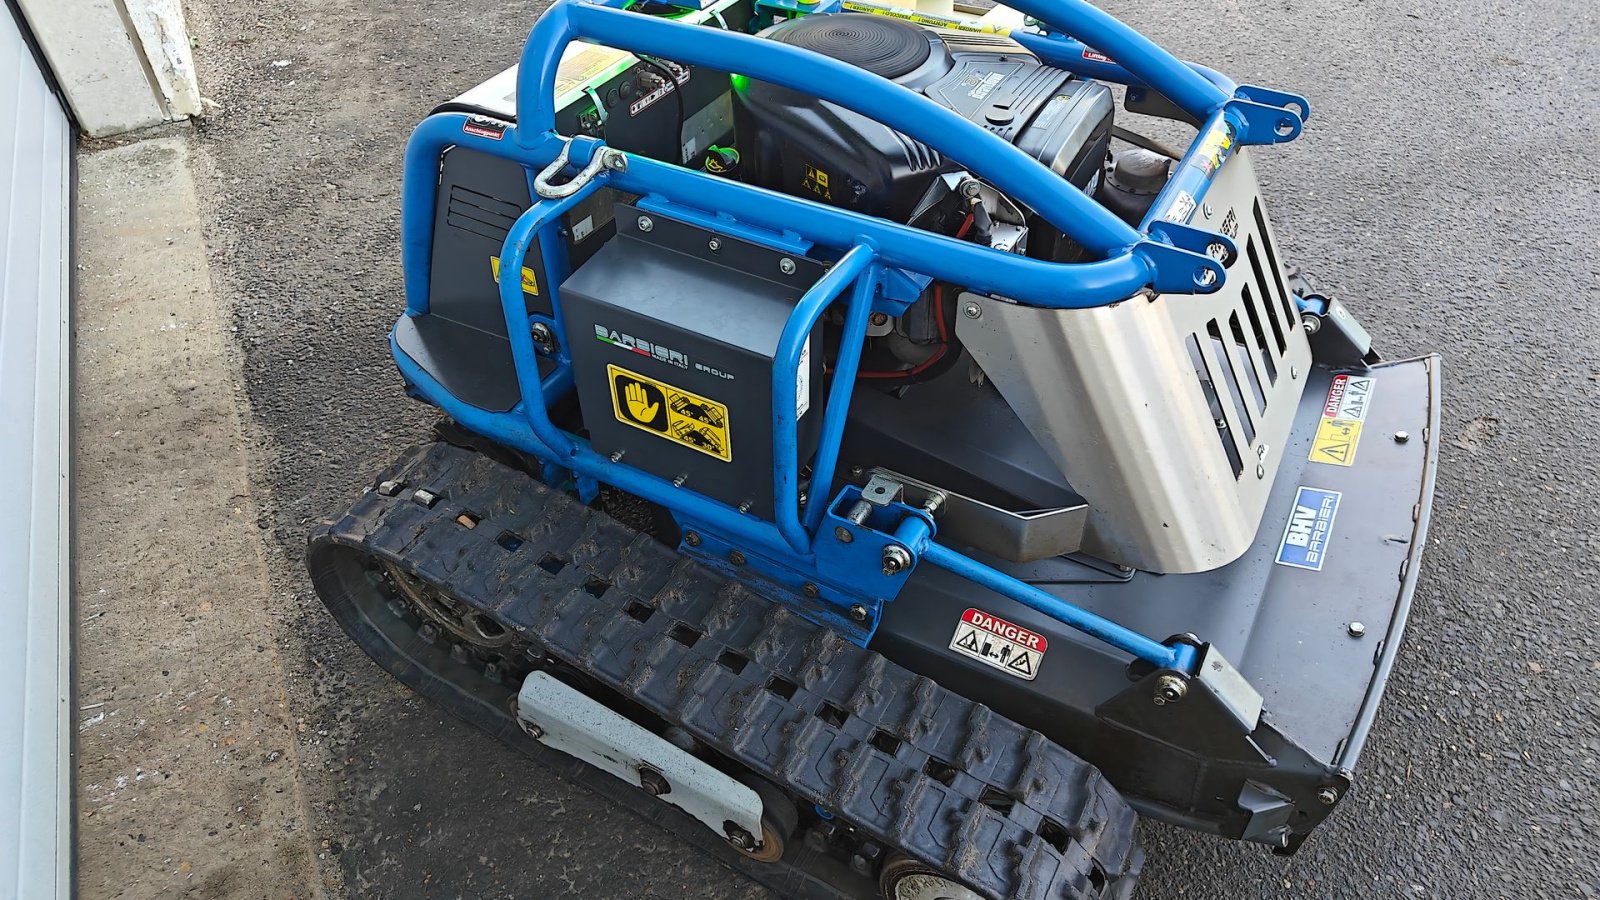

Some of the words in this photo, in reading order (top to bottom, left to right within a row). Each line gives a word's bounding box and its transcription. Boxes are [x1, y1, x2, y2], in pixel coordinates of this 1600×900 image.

[594, 323, 689, 366] BARBIERI
[695, 362, 735, 380] GROUP
[1326, 378, 1347, 414] DANGER
[1286, 504, 1318, 548] BHV
[1305, 495, 1336, 563] BARBIERI
[971, 612, 1040, 649] DANGER
